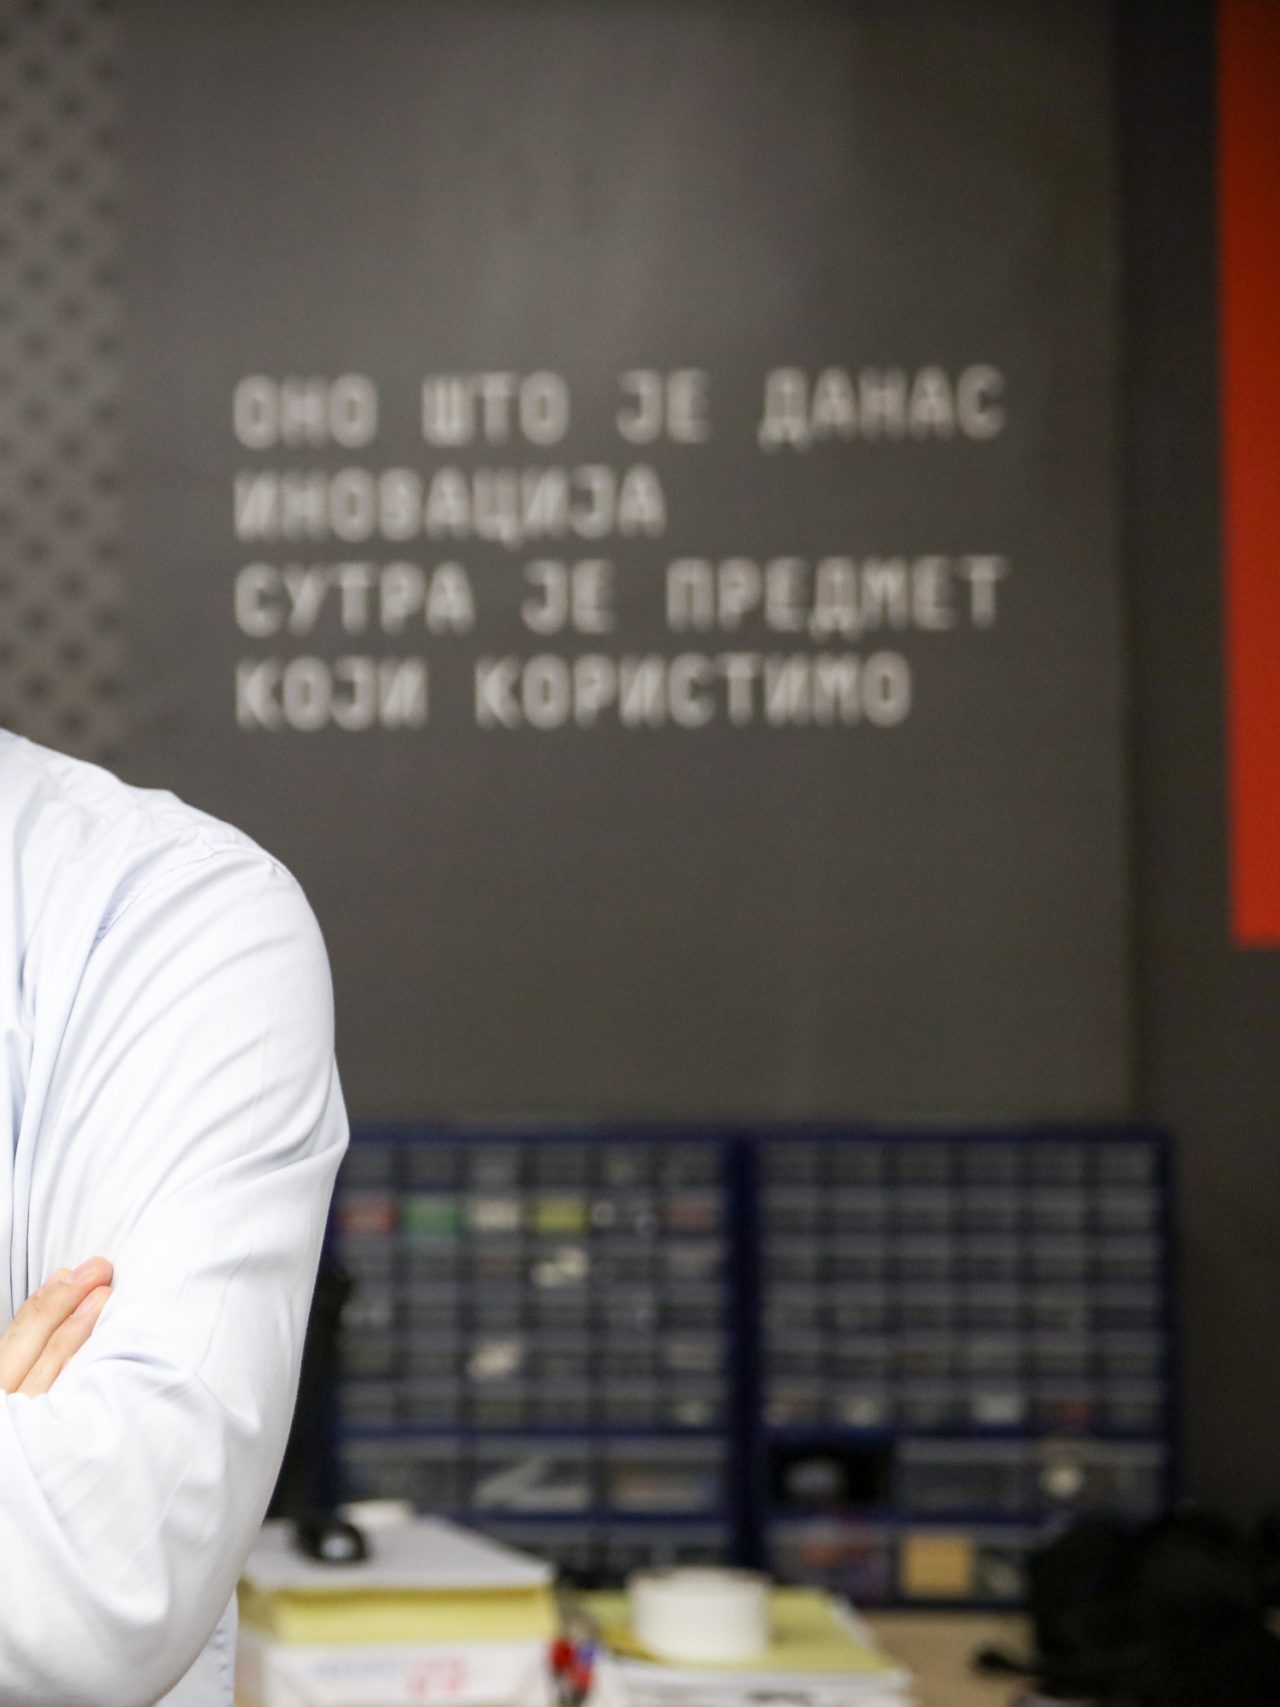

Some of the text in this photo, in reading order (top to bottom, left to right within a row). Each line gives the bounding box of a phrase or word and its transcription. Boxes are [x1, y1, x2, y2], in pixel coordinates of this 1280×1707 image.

[233, 364, 1005, 452] ОНО ШТО ЈЕ ДАНАС
[233, 466, 666, 546] ИНОВАЦИЈА
[234, 555, 1007, 641] СУТРА ЈЕ ПРЕДМЕТ
[235, 652, 912, 731] КОЈИ КОРИСТИМО
